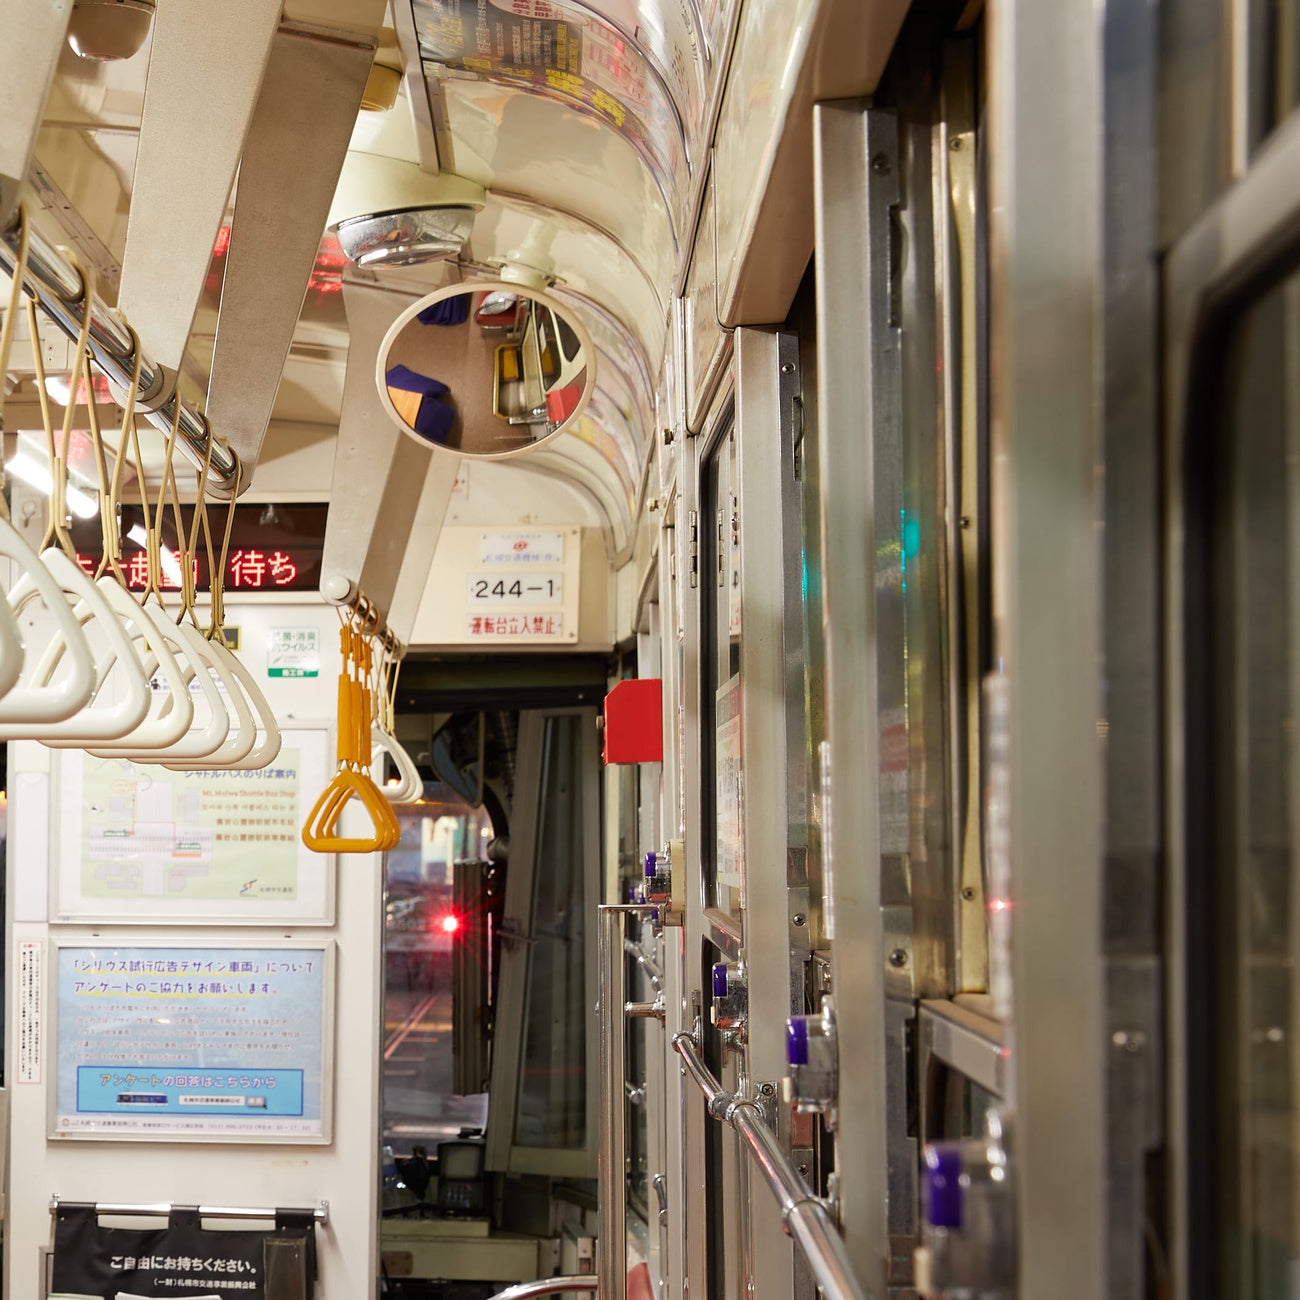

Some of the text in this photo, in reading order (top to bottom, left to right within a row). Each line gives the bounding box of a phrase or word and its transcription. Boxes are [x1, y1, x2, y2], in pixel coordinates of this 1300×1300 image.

[231, 550, 296, 587] 待ち
[475, 580, 553, 598] 244-1
[472, 616, 555, 635] 運転台立入禁止
[100, 1073, 277, 1089] アンケートの回答はこちらから
[110, 1256, 257, 1274] ご自由にお持ちください。
